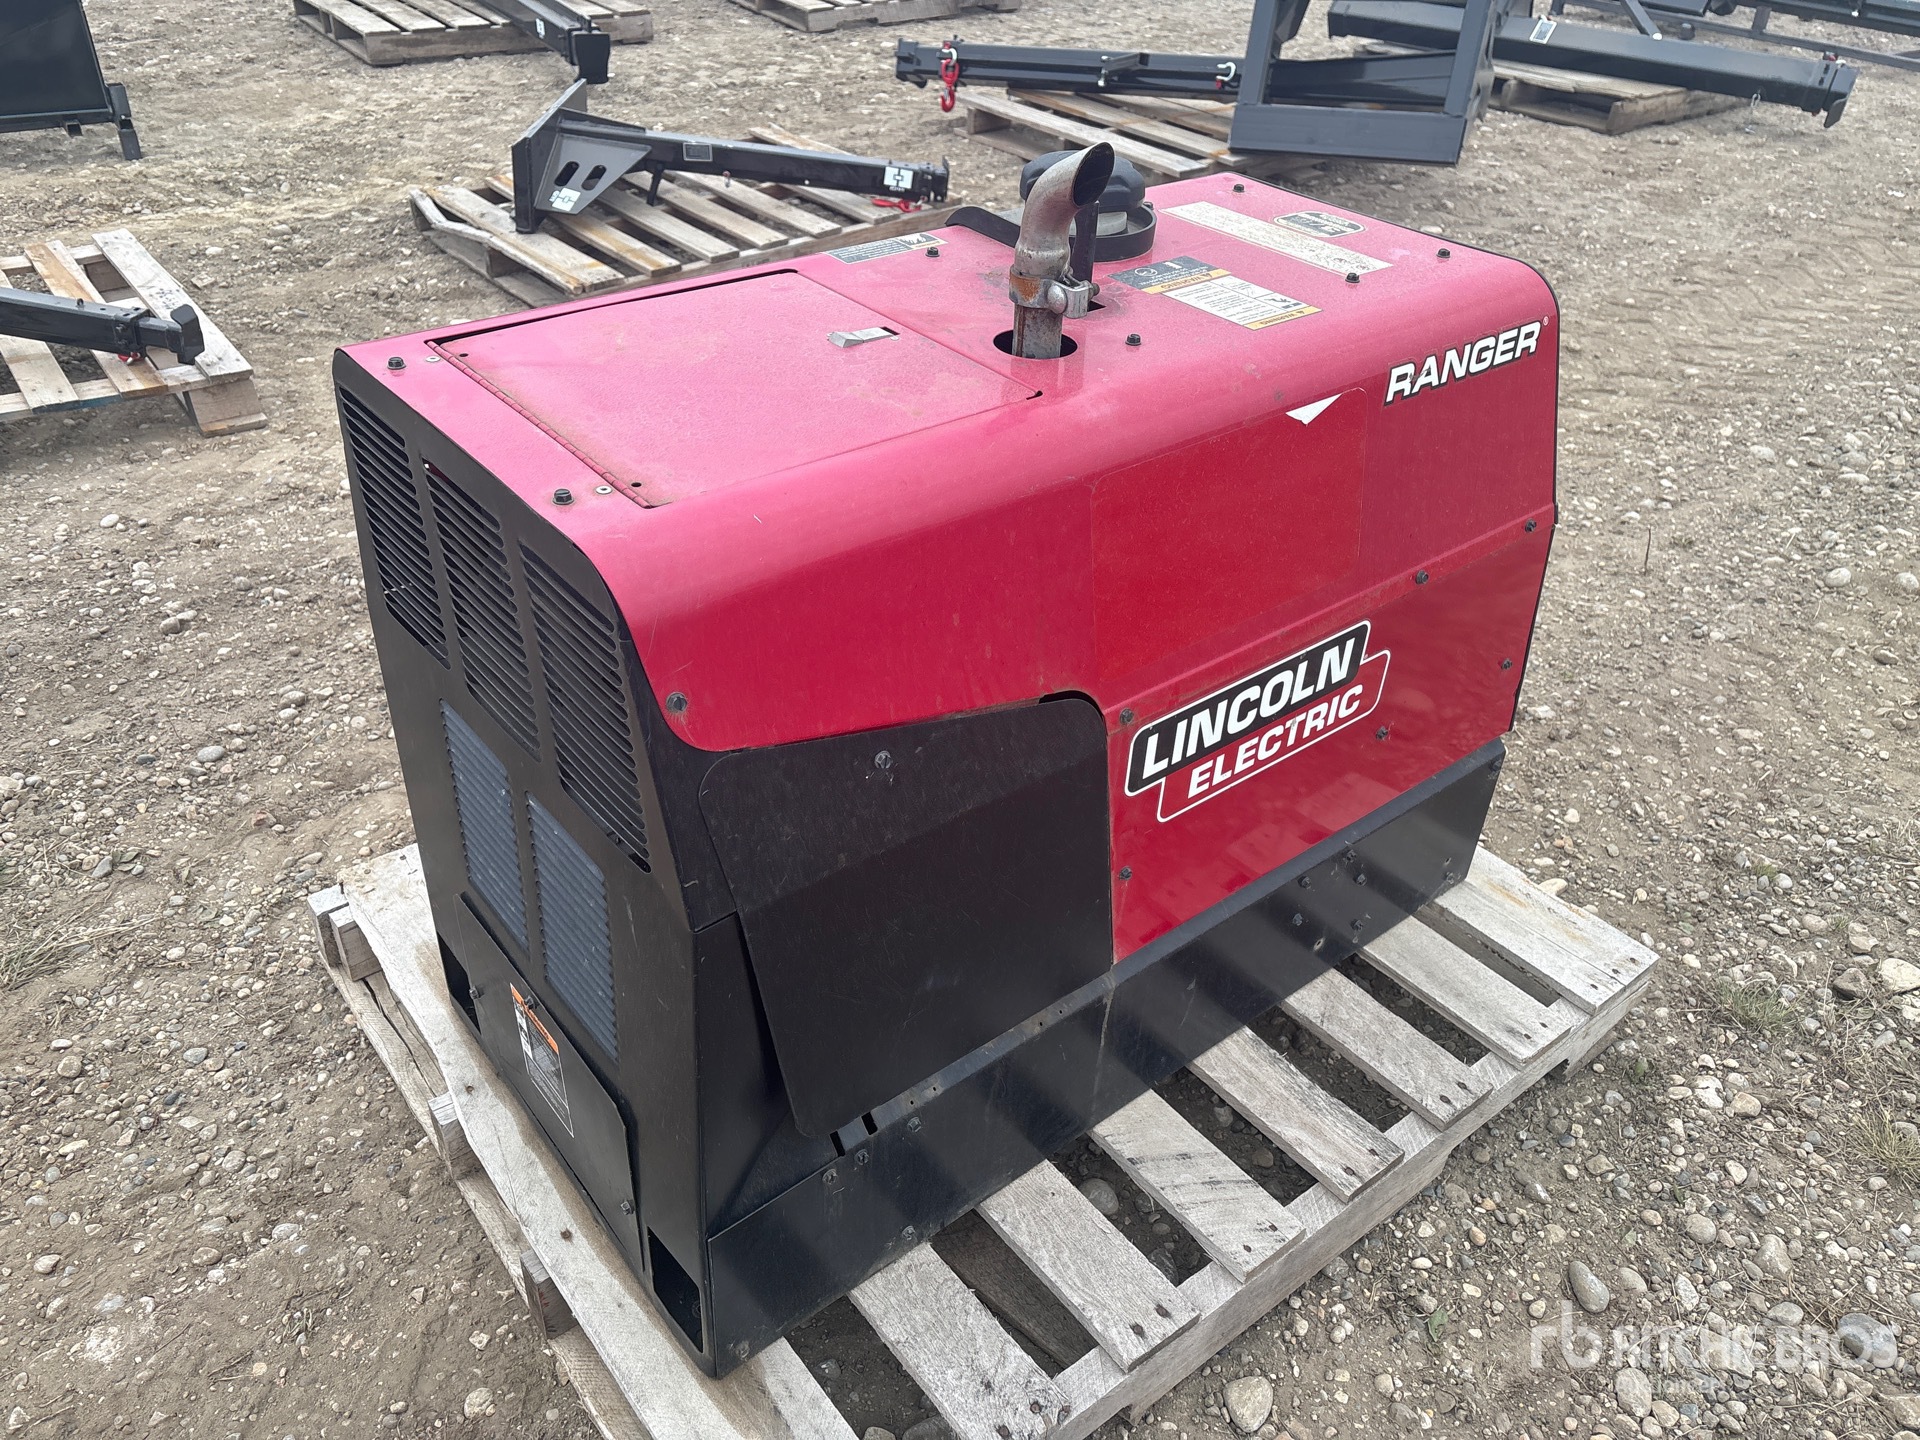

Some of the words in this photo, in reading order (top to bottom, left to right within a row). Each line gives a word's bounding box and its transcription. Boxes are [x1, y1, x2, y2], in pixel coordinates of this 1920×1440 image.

[1160, 273, 1203, 290] WARNING
[1384, 320, 1541, 405] RANGER
[1142, 637, 1356, 780] LINCOLN
[1187, 684, 1364, 800] ELECTRIC
